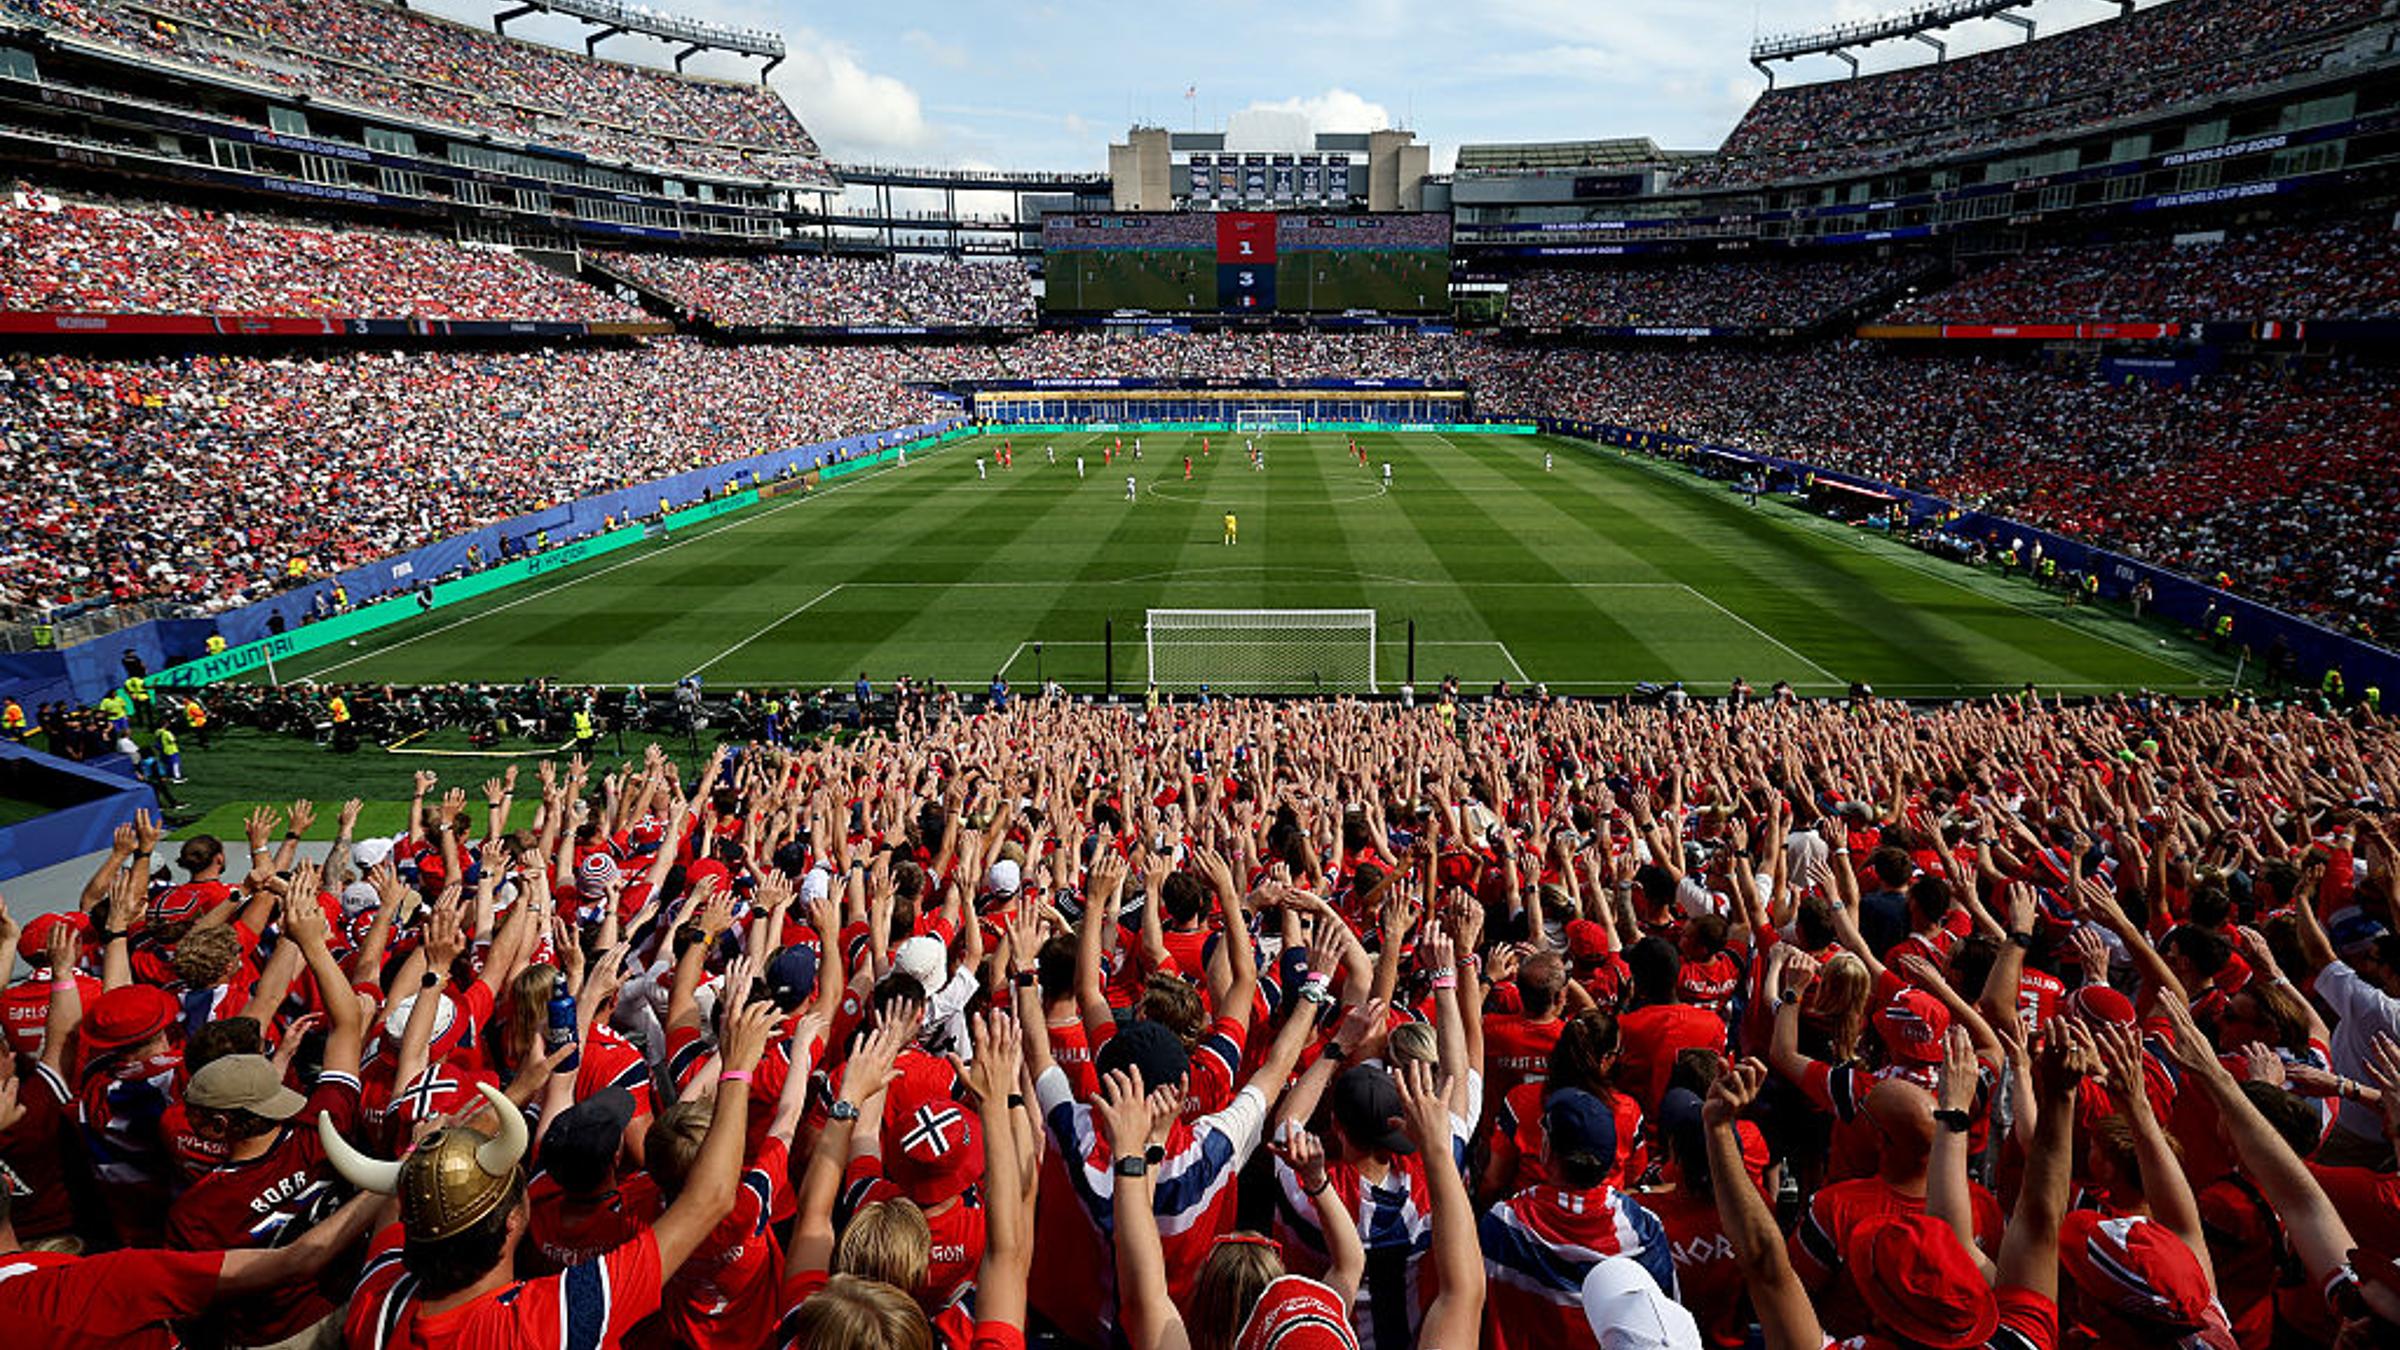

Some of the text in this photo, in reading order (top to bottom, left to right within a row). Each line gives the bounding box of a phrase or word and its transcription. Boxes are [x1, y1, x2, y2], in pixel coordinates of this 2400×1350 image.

[278, 137, 314, 151] WORLD
[316, 143, 336, 154] CUP
[2163, 154, 2185, 167] FIFA
[2187, 148, 2224, 162] WORLD
[2224, 143, 2247, 156] CUP
[287, 183, 324, 196] WORLD
[325, 187, 343, 198] CUP
[2156, 195, 2178, 207] FIFA
[2179, 191, 2216, 204] WORLD
[2217, 188, 2239, 200] CUP
[1239, 241, 1255, 254] 1
[1239, 271, 1255, 286] 3
[355, 320, 369, 334] 3
[2189, 323, 2203, 338] 3
[204, 637, 294, 678] HYUNDAI
[1670, 1234, 1736, 1266] NOR
